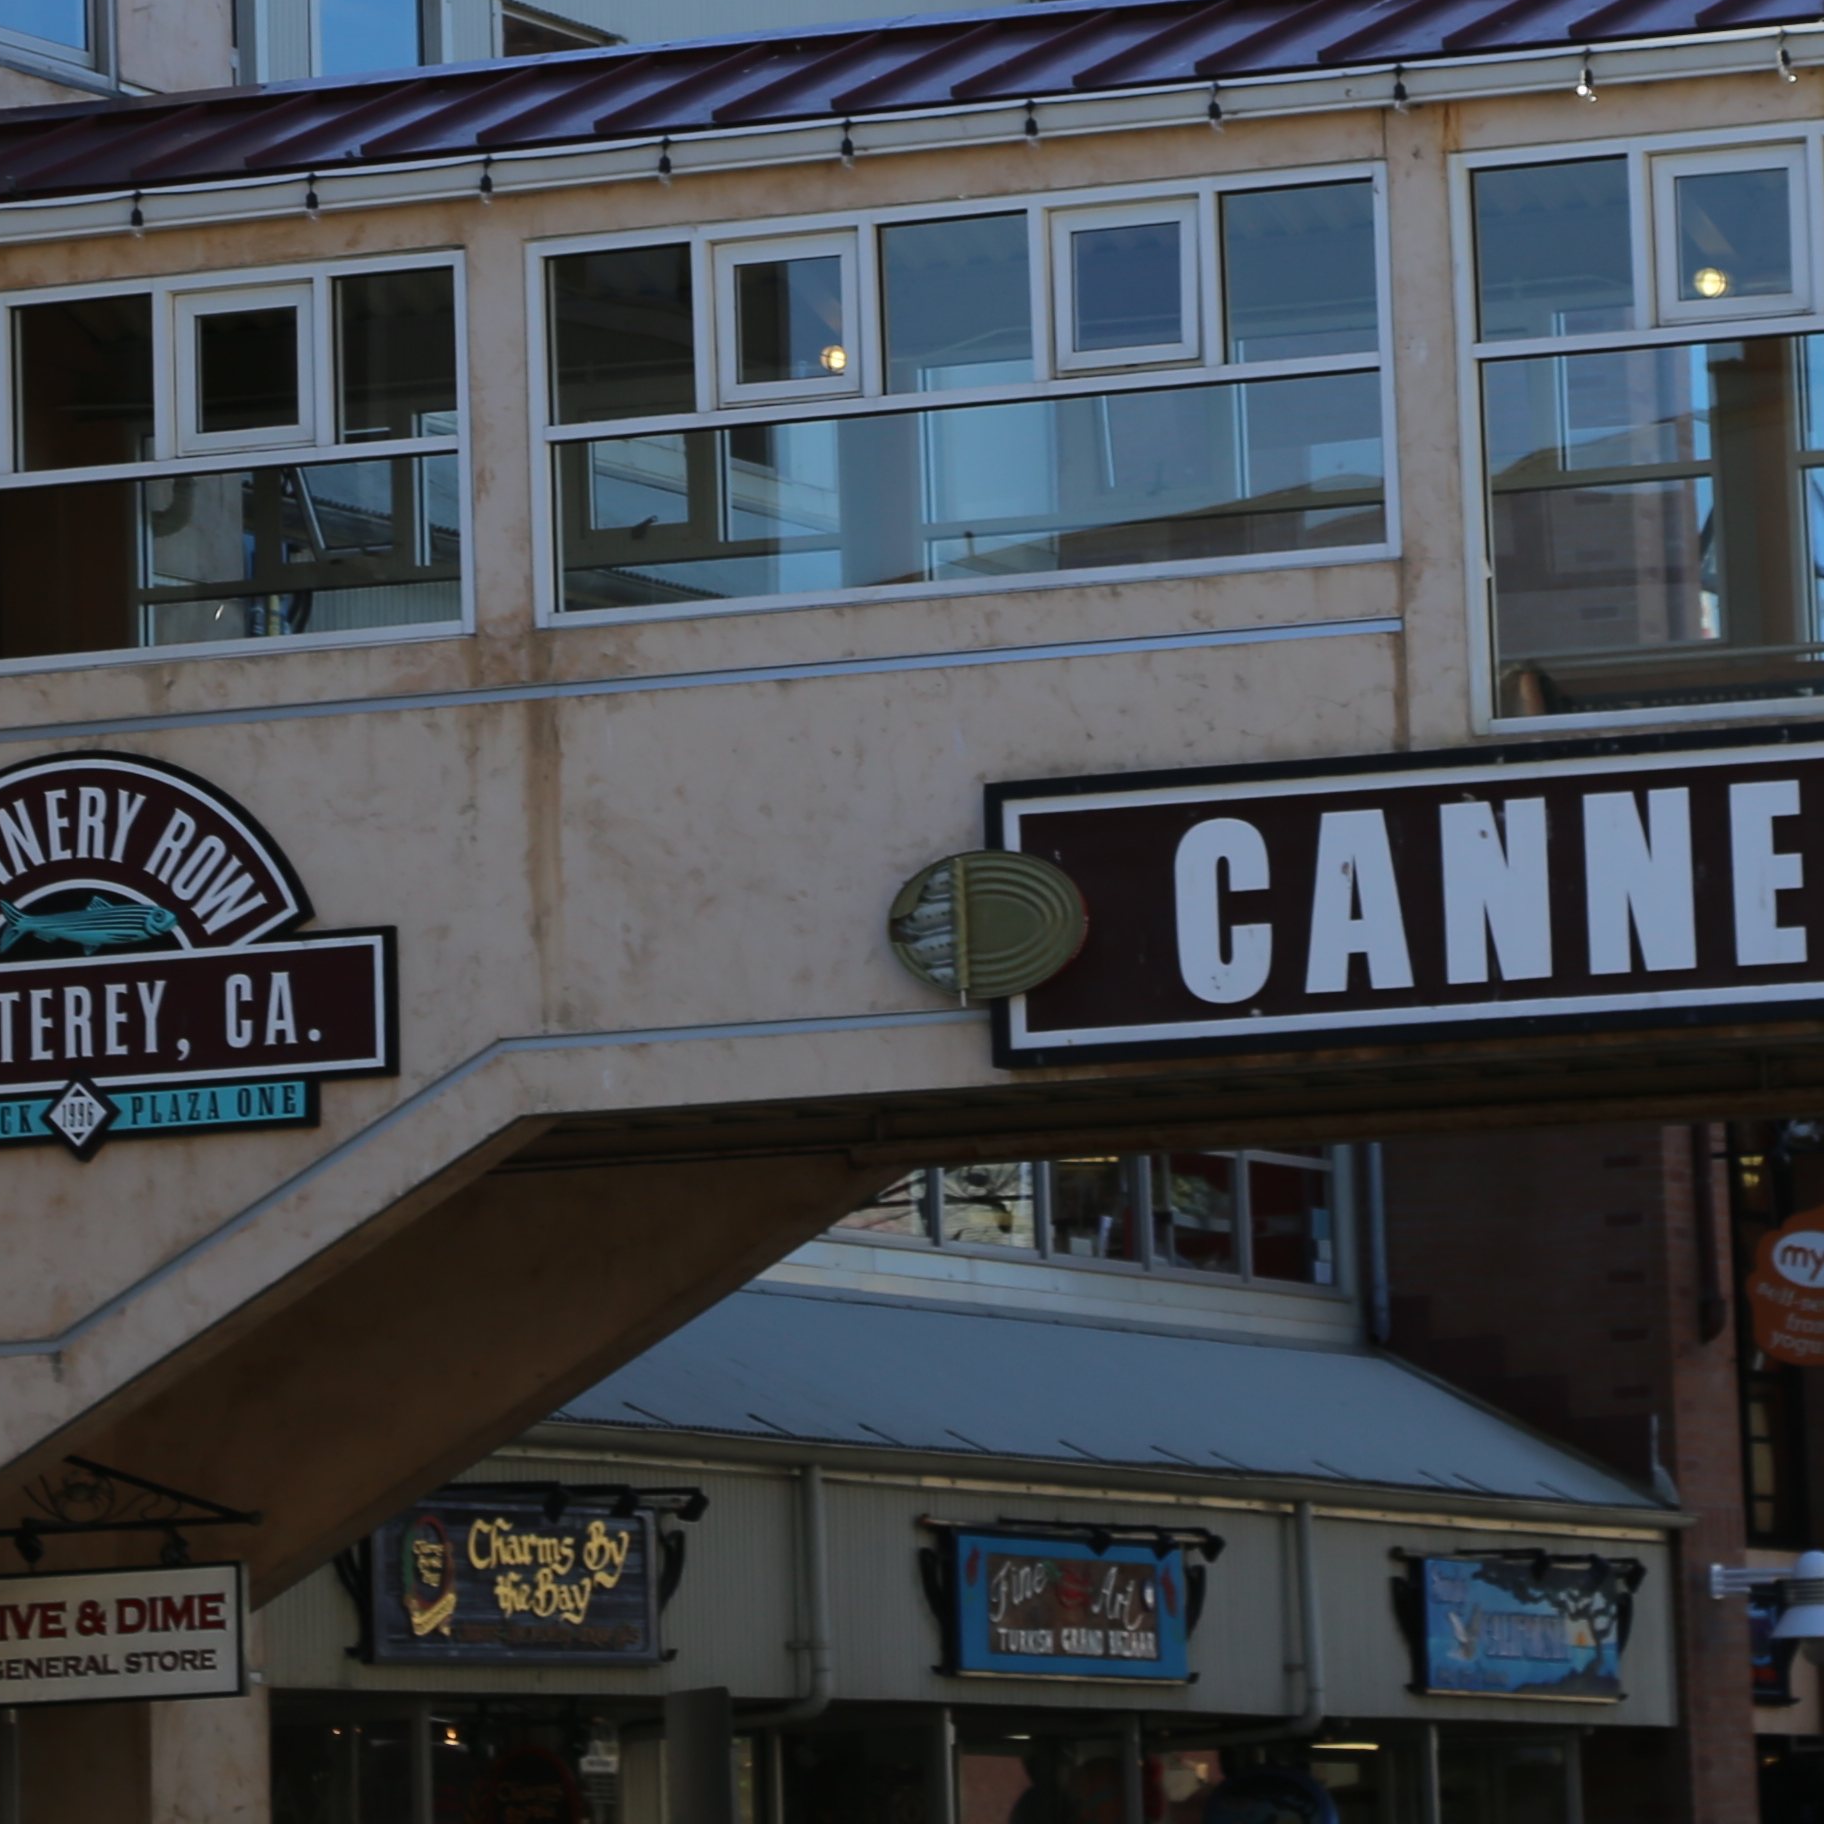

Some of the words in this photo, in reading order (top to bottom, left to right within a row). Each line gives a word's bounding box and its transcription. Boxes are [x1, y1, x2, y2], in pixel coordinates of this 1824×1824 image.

[143, 808, 266, 936] ROW
[224, 972, 322, 1050] CA.
[61, 1099, 95, 1129] 1996
[130, 1087, 223, 1126] PLAZA
[237, 1083, 297, 1119] ONE
[467, 1517, 575, 1575] Charms
[582, 1520, 630, 1588] By
[76, 1600, 106, 1636] &
[116, 1593, 226, 1634] DIME
[493, 1571, 531, 1618] the
[530, 1568, 592, 1625] Bay
[989, 1560, 1047, 1623] Fine
[1091, 1565, 1144, 1630] Art
[125, 1649, 216, 1674] STORE
[1061, 1627, 1104, 1656] GRAND
